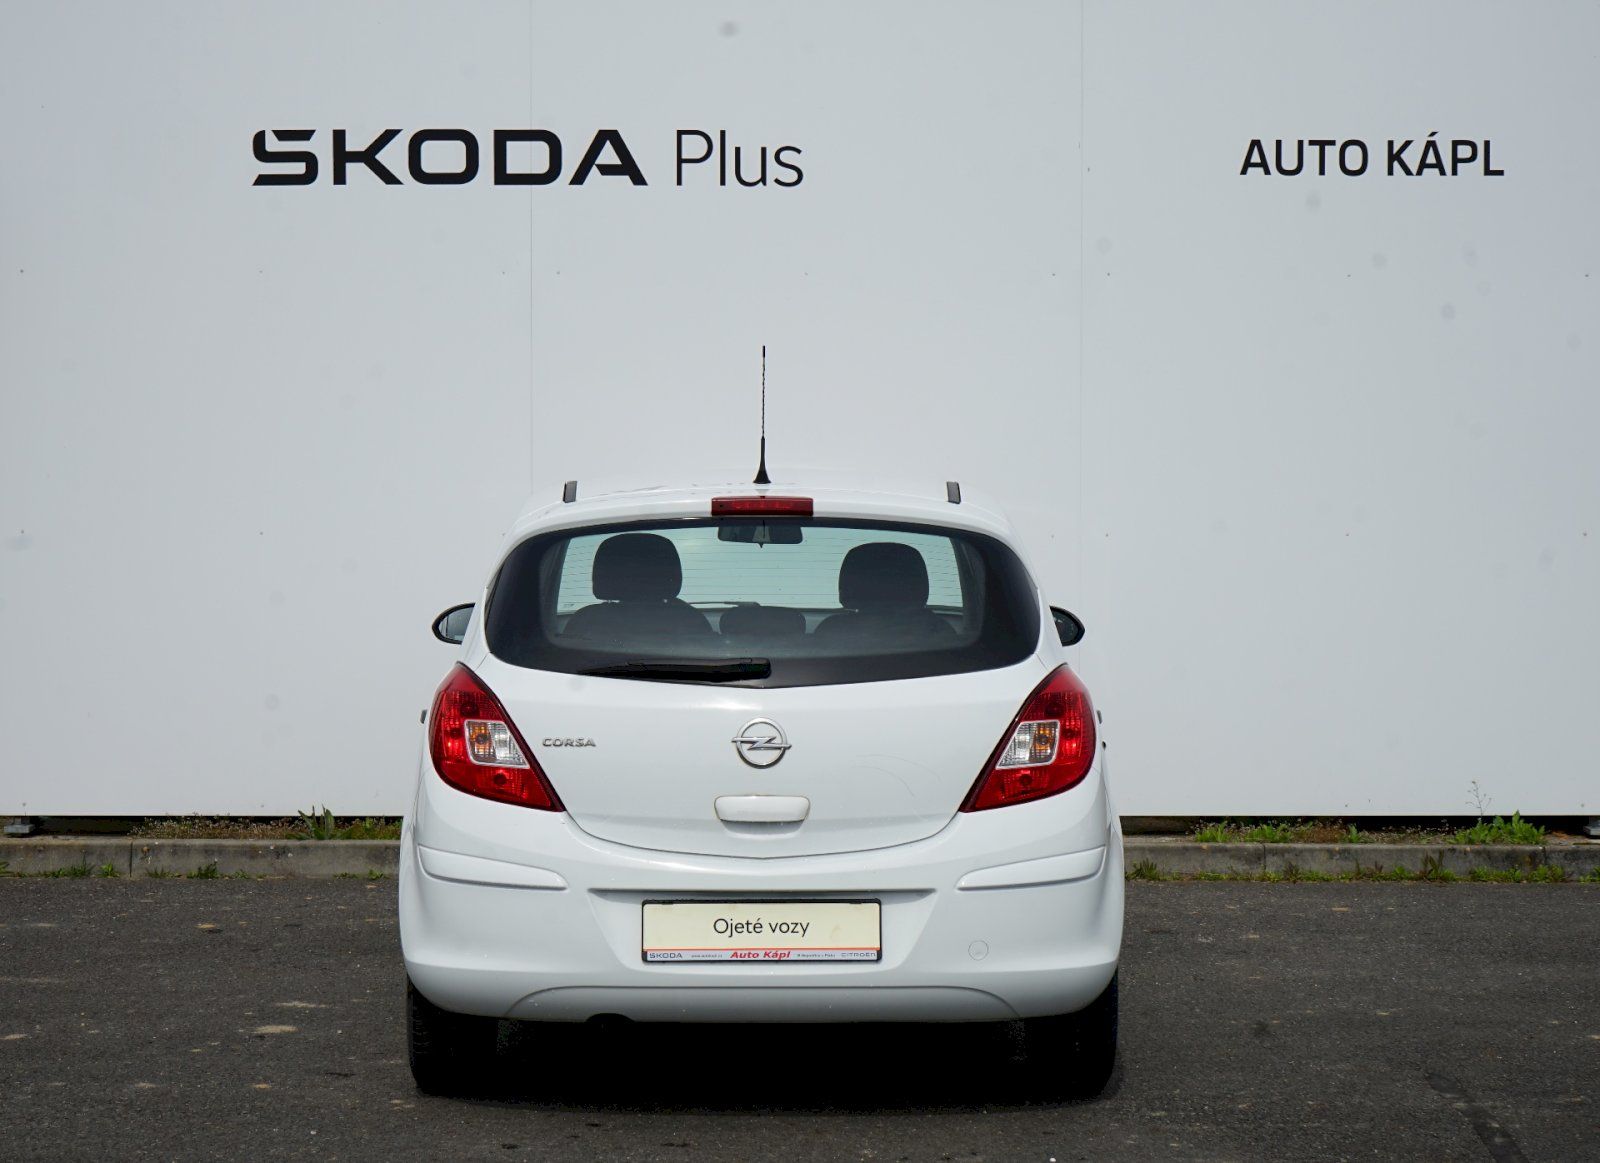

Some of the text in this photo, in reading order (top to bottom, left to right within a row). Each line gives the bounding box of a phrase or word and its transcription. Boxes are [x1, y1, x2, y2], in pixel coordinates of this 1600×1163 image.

[676, 129, 804, 187] Plus
[1240, 131, 1505, 176] AUTO KÁPL
[542, 738, 597, 748] CORSA
[713, 917, 810, 938] Ojeté vozy
[730, 951, 759, 959] Auto
[763, 950, 791, 961] Kápl
